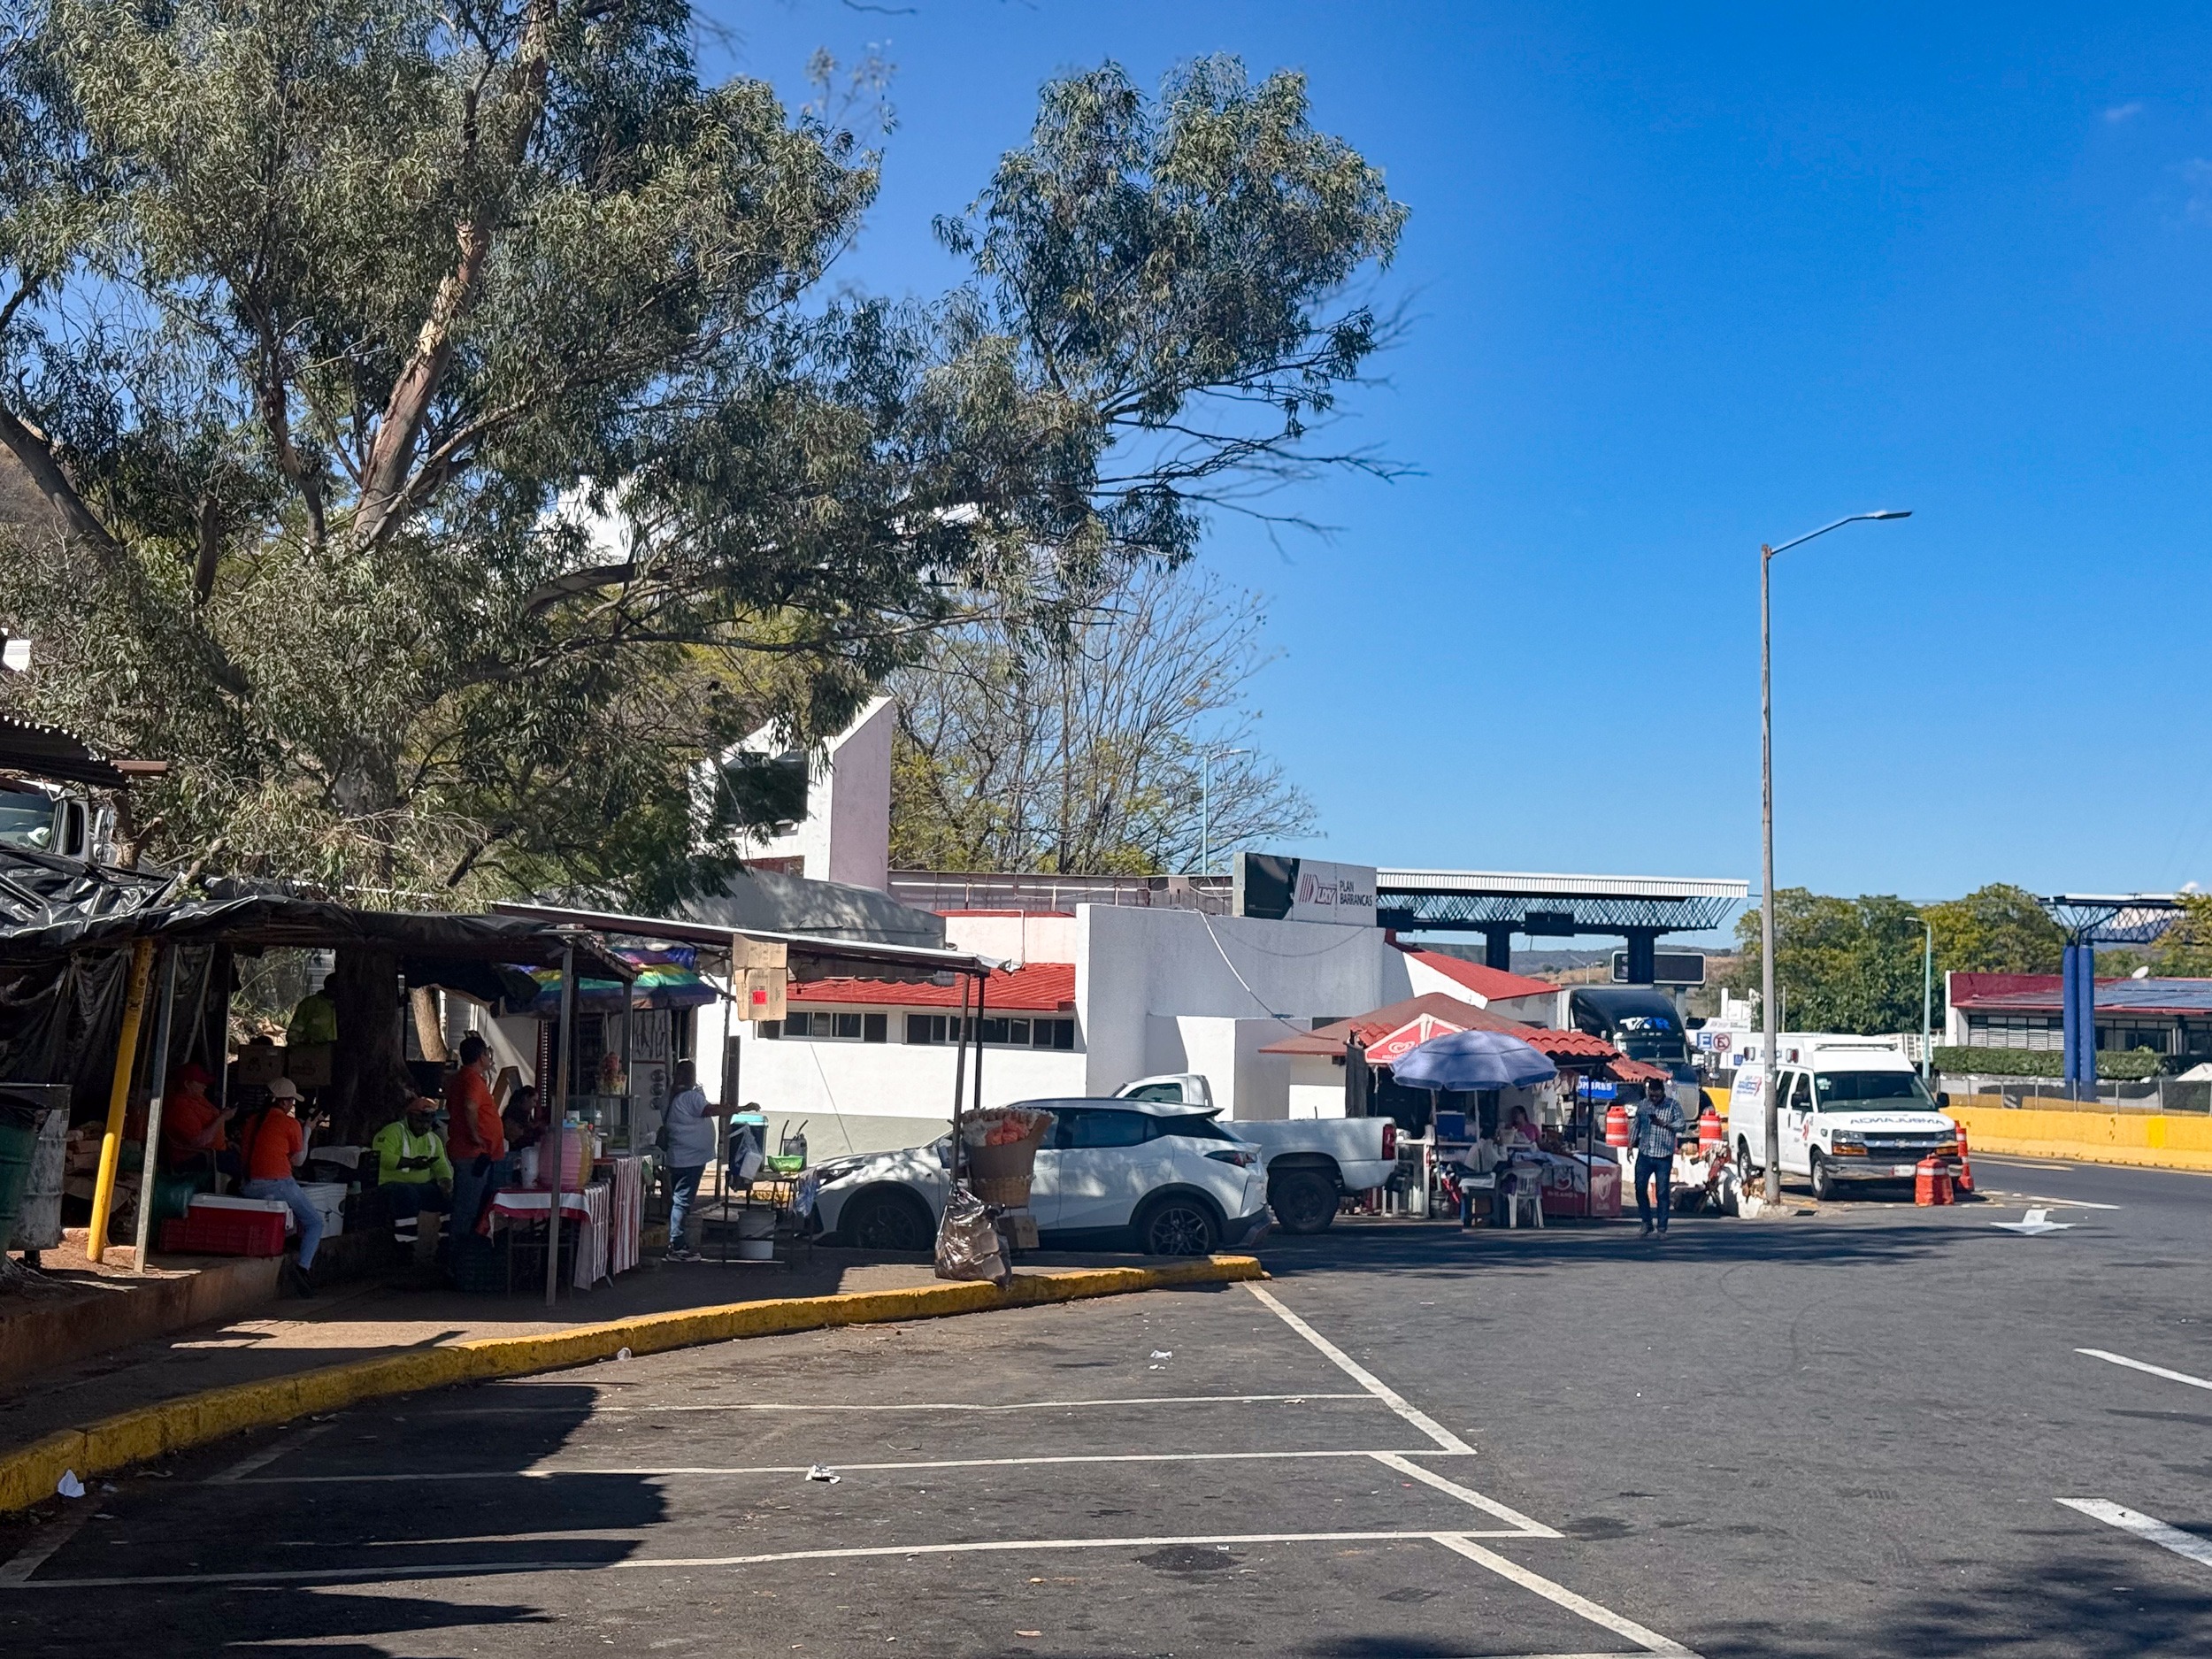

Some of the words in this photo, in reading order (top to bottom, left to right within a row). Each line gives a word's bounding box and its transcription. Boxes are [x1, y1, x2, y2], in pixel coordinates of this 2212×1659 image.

[1340, 879, 1355, 893] PLAN
[1340, 893, 1373, 907] BARRANCAS
[1701, 1033, 1711, 1048] E
[1578, 1081, 1613, 1091] OMBRES
